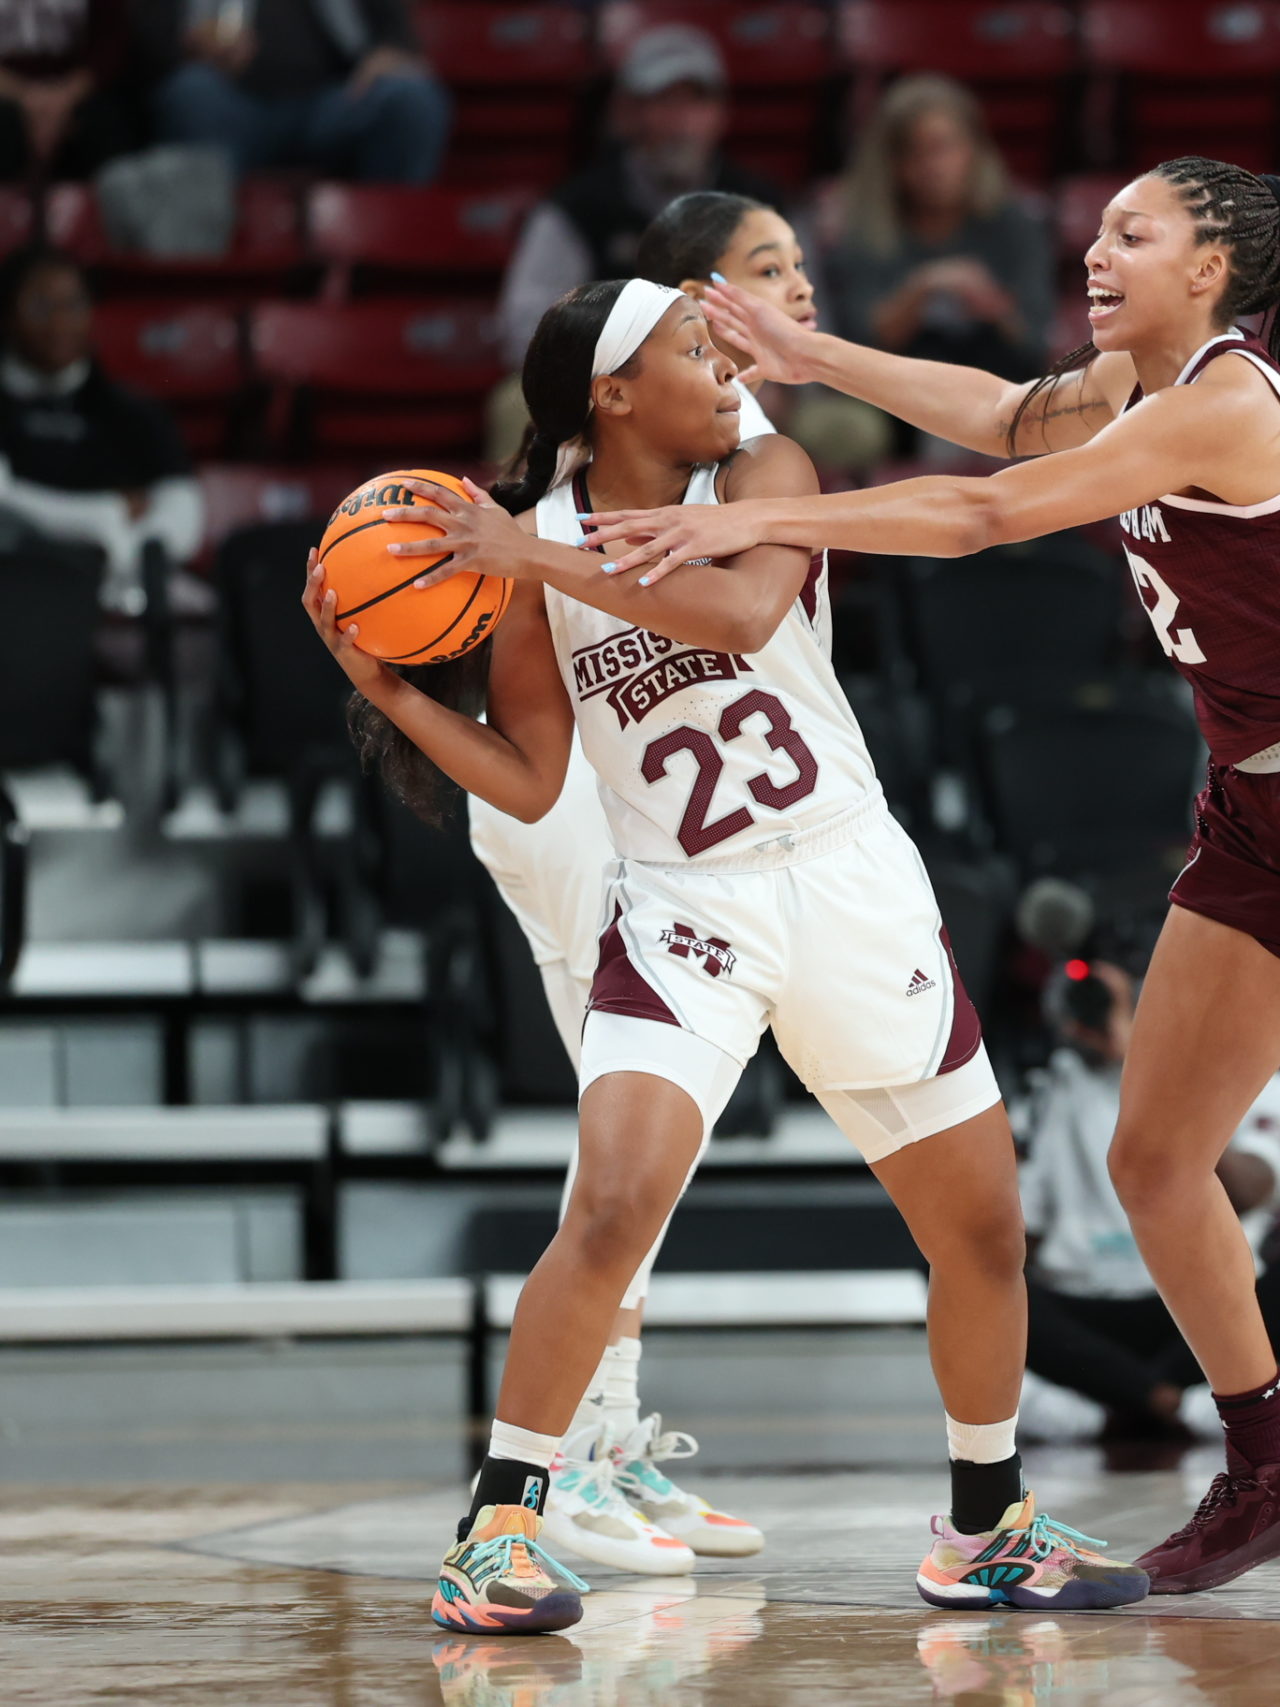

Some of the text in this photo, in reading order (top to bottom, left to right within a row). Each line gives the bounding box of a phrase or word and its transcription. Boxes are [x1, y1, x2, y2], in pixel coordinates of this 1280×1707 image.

[573, 629, 684, 693] MISSIS
[631, 654, 723, 710] STATE
[640, 688, 819, 859] 23
[674, 935, 725, 962] STATE
[906, 980, 937, 997] adidas
